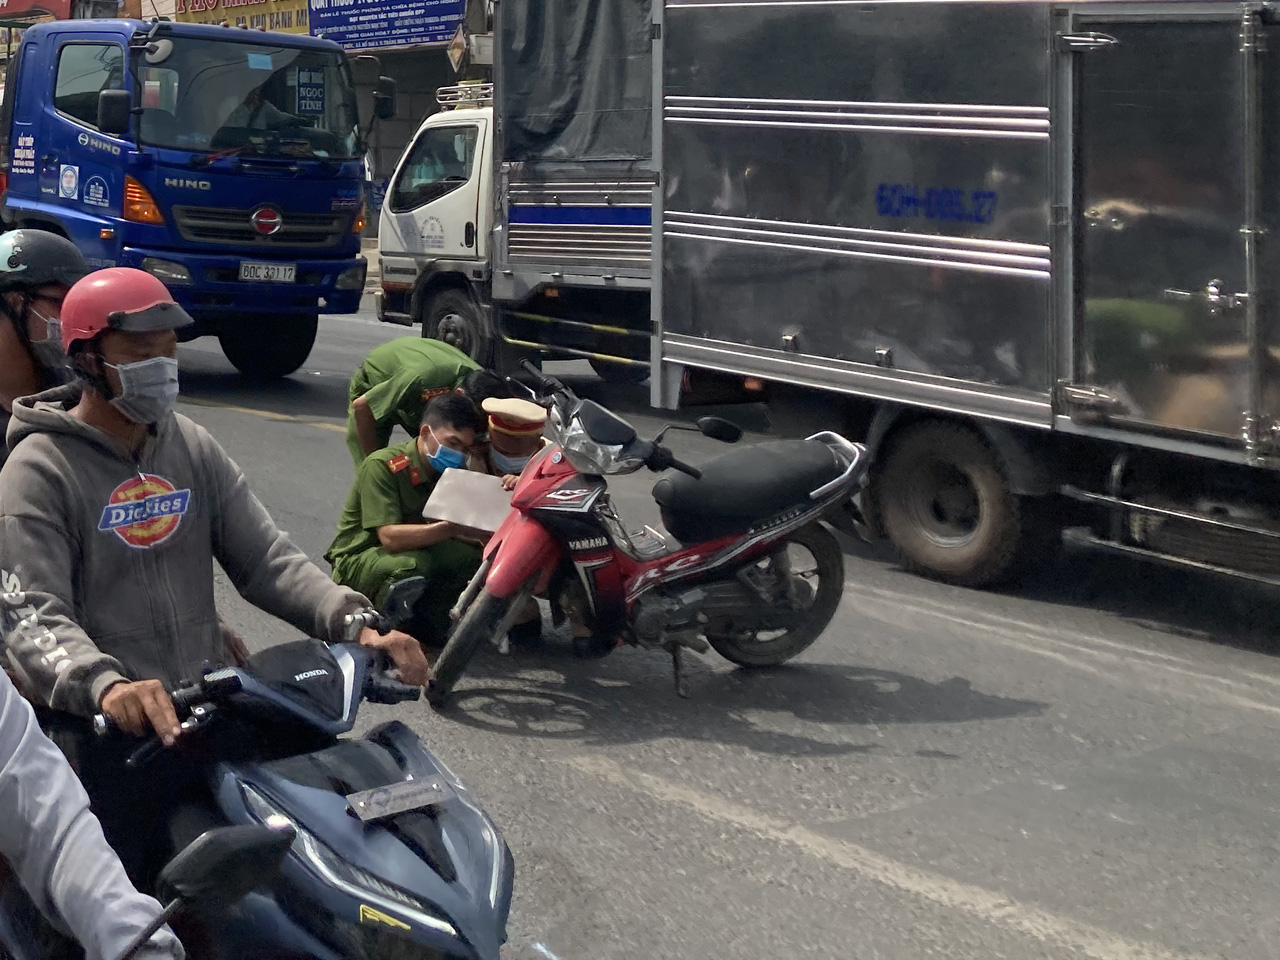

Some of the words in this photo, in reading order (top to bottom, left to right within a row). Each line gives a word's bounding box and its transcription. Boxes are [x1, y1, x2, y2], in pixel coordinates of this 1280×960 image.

[90, 138, 121, 156] HINO
[164, 177, 211, 190] HINO
[569, 536, 609, 551] YAMAHA
[294, 668, 329, 682] HONDA
